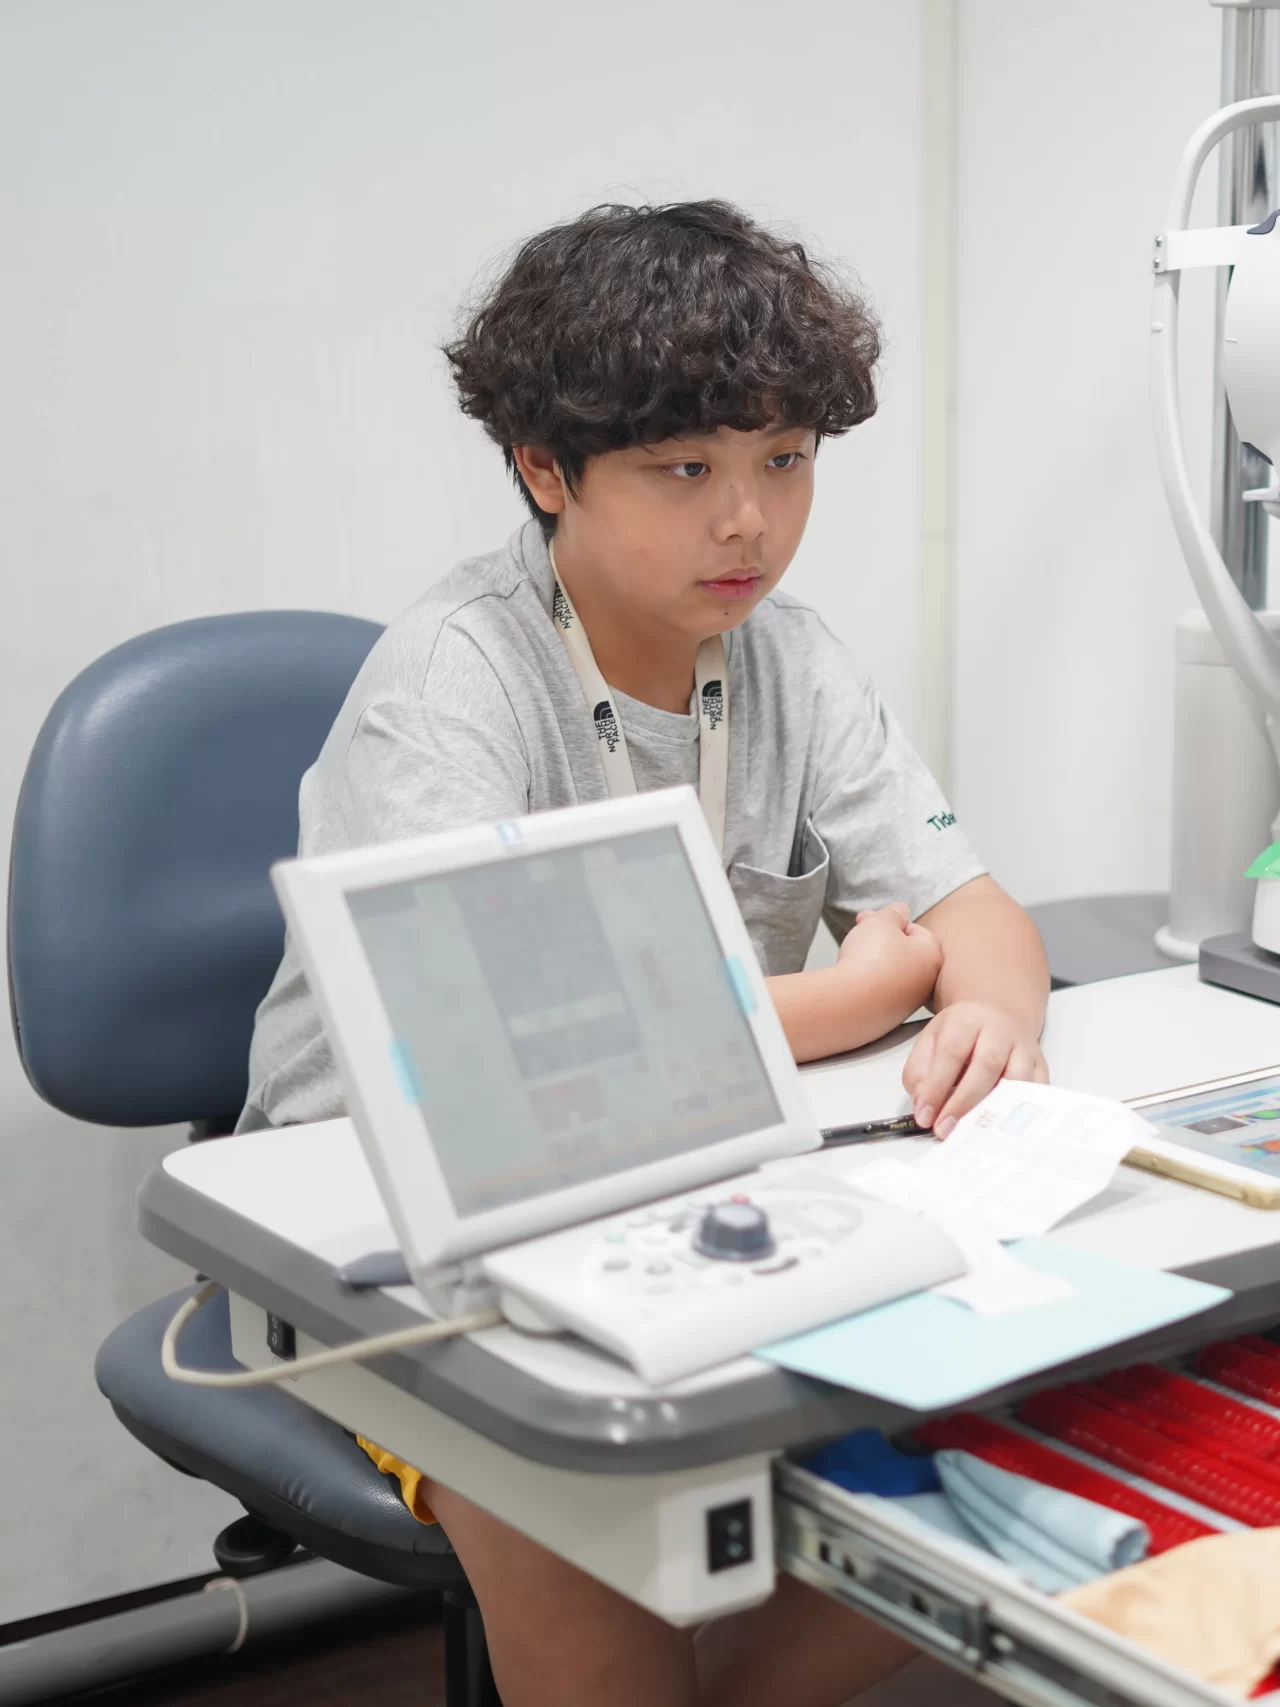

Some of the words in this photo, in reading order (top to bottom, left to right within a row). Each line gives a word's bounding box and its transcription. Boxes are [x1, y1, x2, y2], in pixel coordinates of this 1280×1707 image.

[559, 597, 574, 619] FACE
[702, 697, 711, 716] THE
[709, 697, 717, 730] NORTH
[715, 697, 724, 721] FACE
[595, 720, 606, 740] THE
[601, 719, 616, 752] NORTH
[610, 717, 620, 742] FACE
